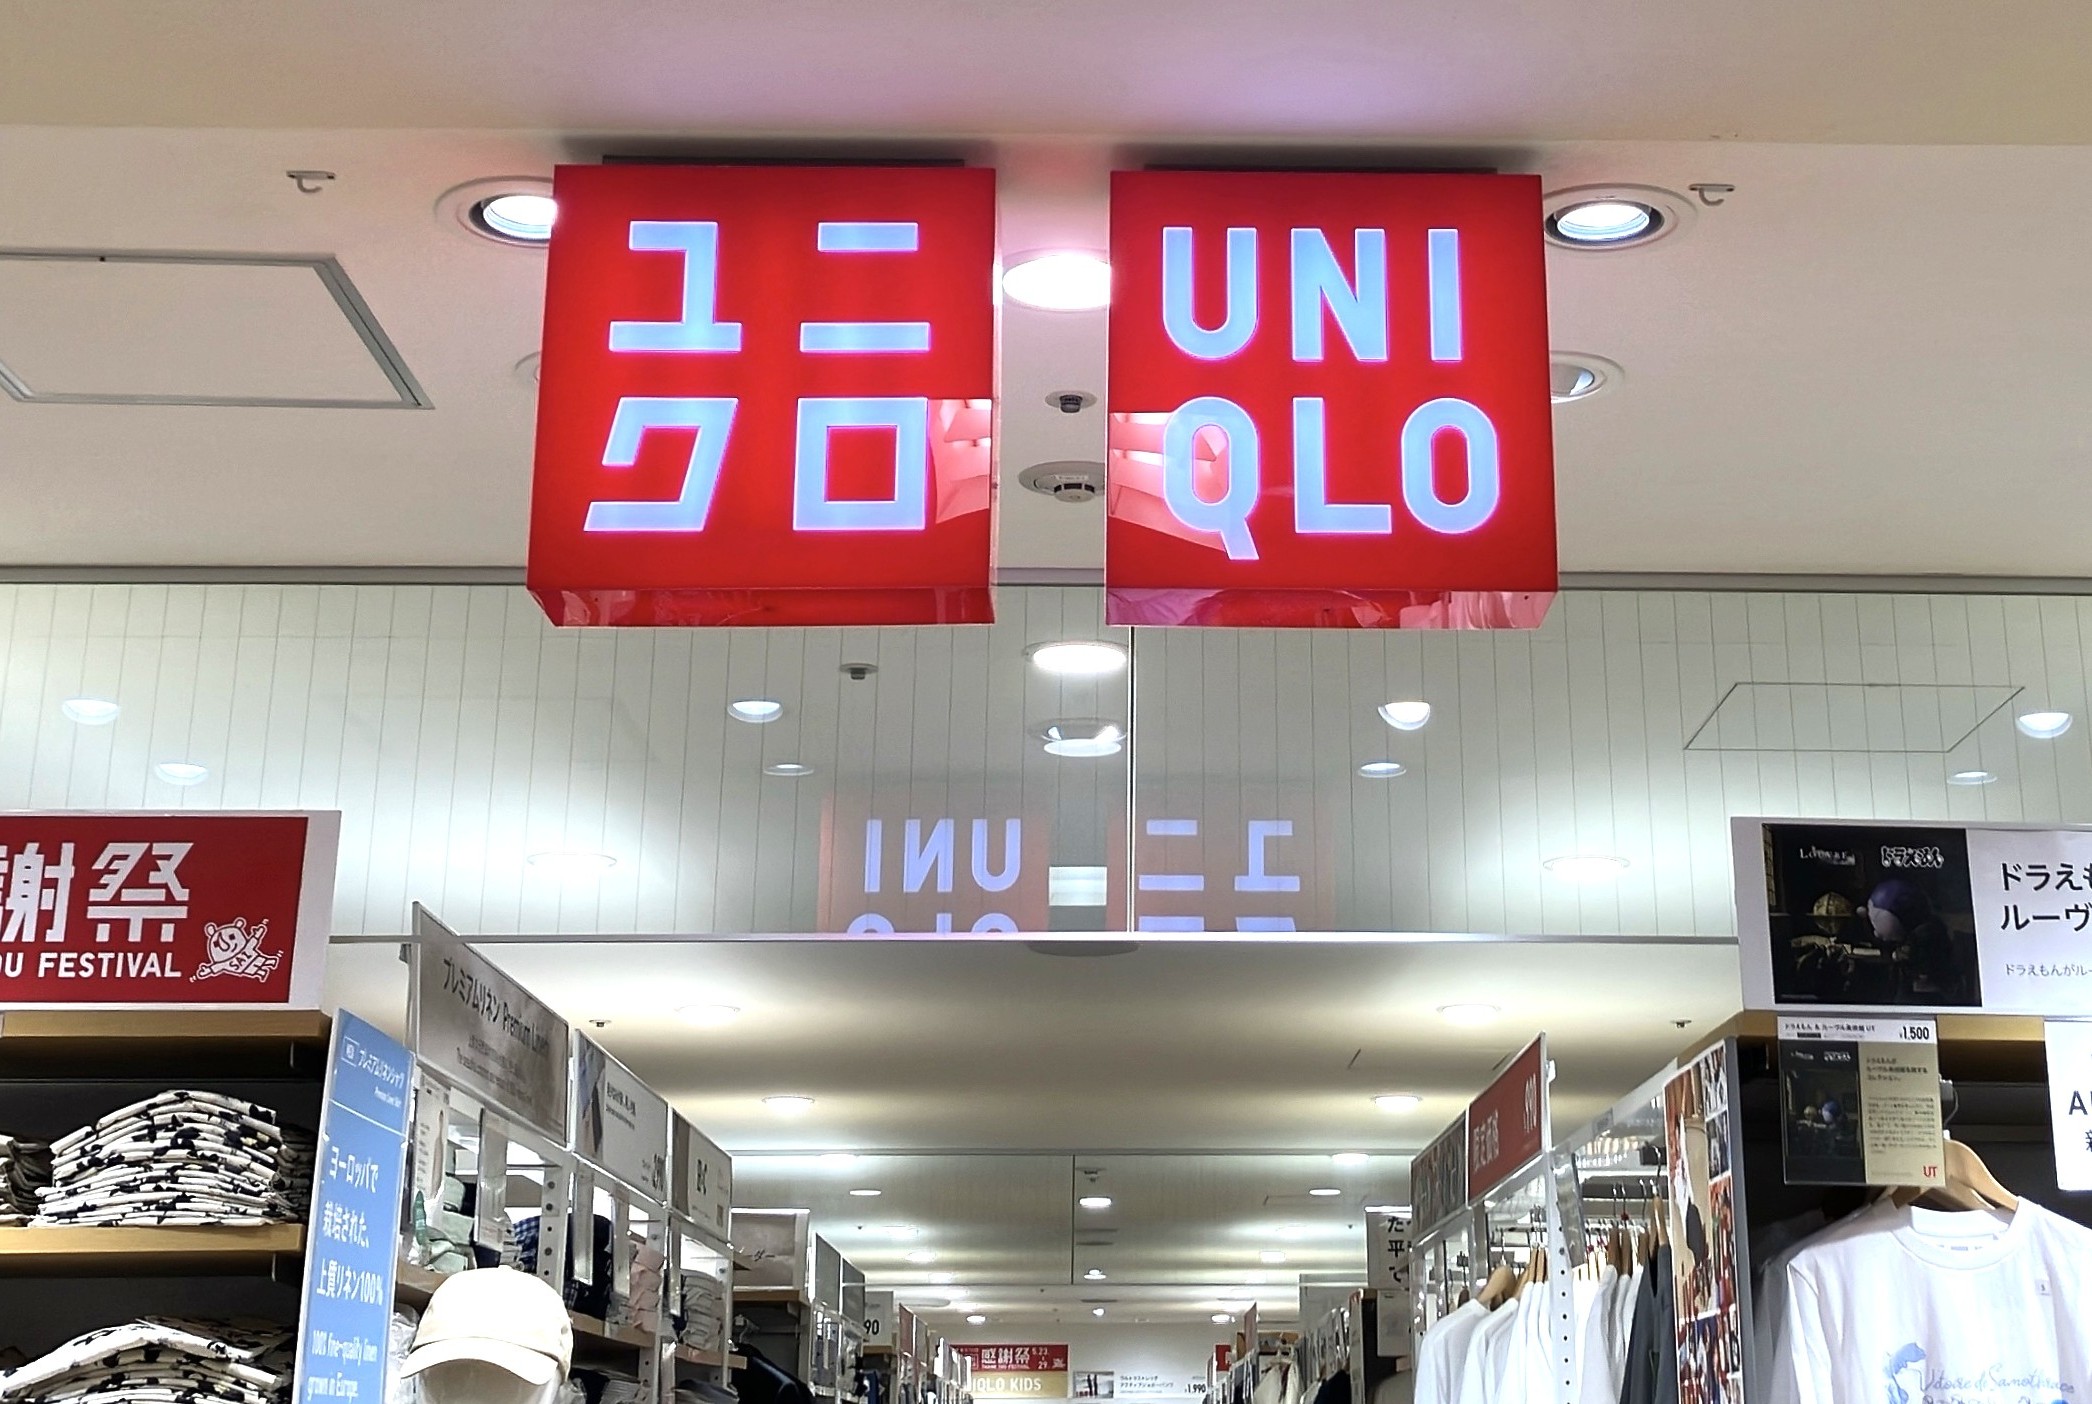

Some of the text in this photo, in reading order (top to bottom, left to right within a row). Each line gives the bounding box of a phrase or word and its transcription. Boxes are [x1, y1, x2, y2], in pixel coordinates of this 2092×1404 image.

[608, 220, 931, 353] ユニ
[1161, 226, 1464, 363] UNI
[583, 396, 929, 533] クロ
[1162, 395, 1502, 561] QLO
[2000, 901, 2092, 932] ルーヴ
[0, 952, 182, 979] U FESTIVAL
[2068, 1090, 2092, 1115] A
[329, 1146, 379, 1194] ヨーロッパで
[1923, 1165, 1938, 1178] UT
[1009, 1378, 1042, 1392] KIDS
